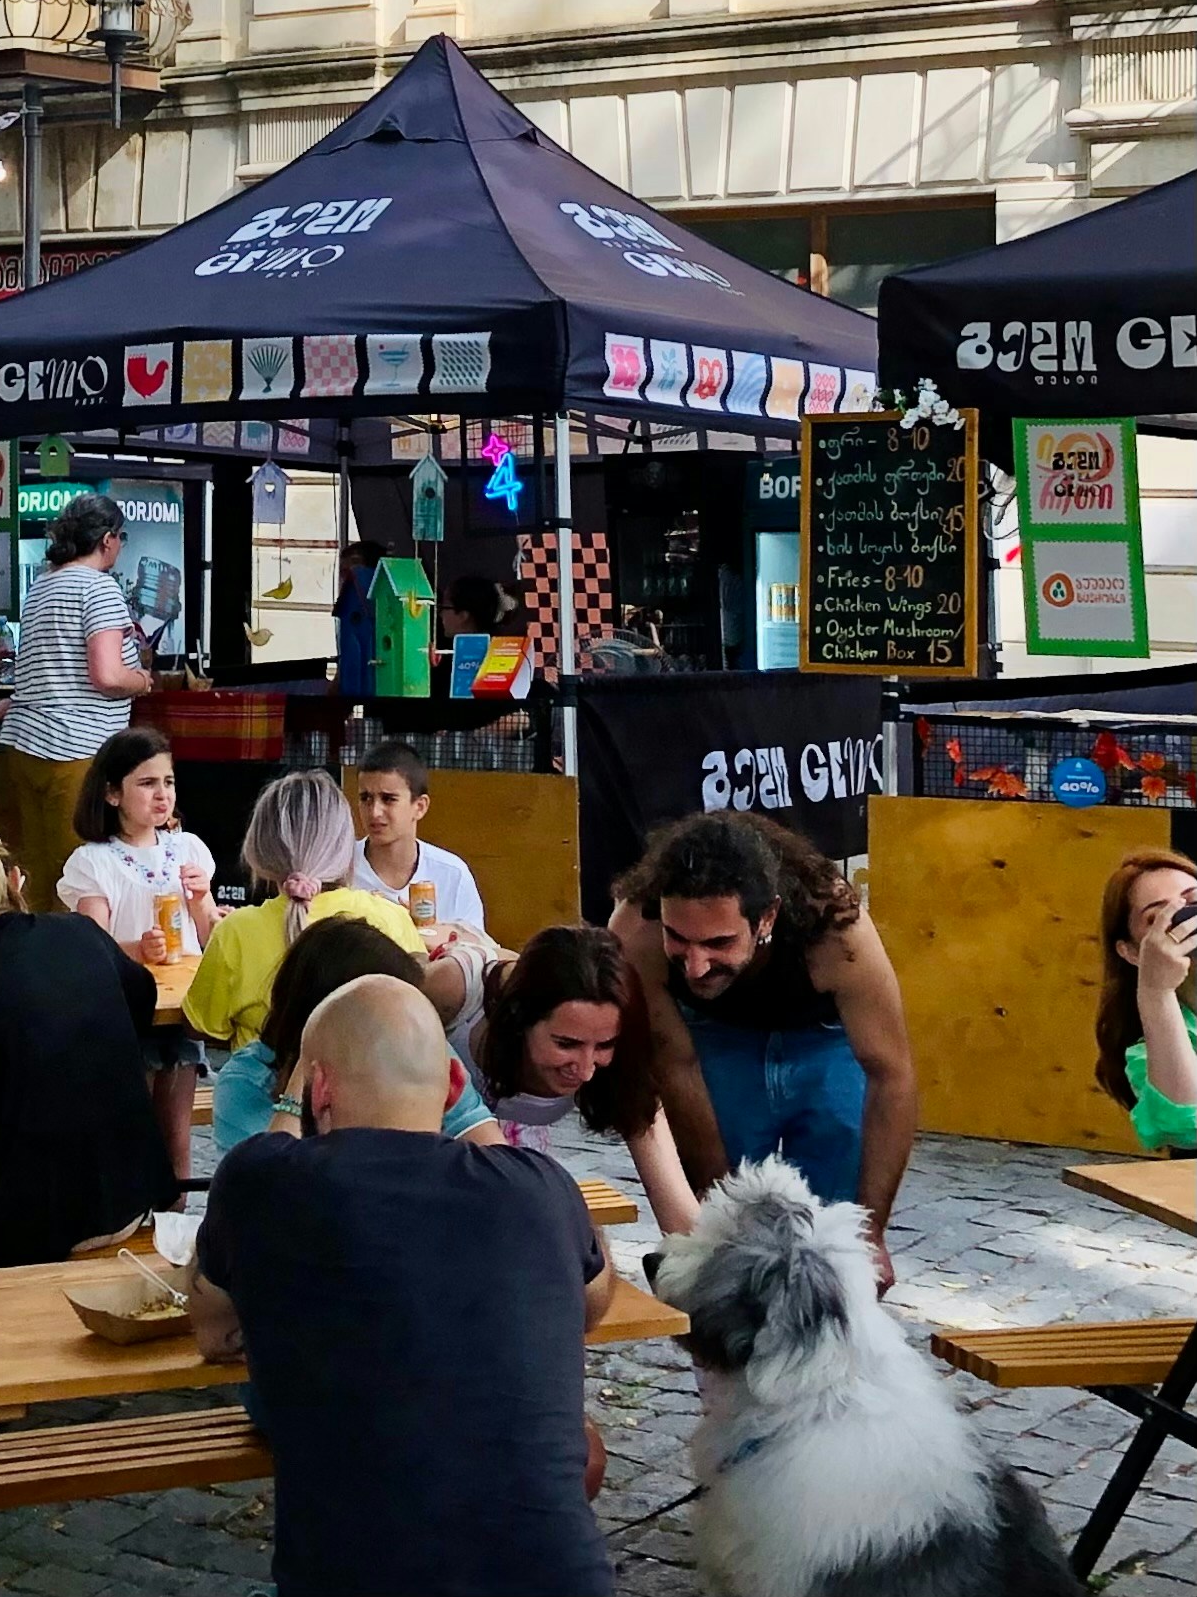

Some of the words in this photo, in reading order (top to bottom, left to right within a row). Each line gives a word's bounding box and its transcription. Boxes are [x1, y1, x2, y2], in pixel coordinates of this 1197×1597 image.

[195, 245, 345, 276] GEMO
[486, 452, 523, 510] 4
[18, 490, 89, 513] ORJOM
[827, 566, 871, 588] Fries
[823, 594, 881, 612] Chicken
[887, 595, 932, 621] Wings
[936, 592, 962, 615] 20
[826, 618, 879, 644] Oyster
[822, 640, 879, 661] Chicken
[887, 639, 916, 661] Box
[927, 639, 952, 664] 15
[1059, 781, 1100, 793] 40%
